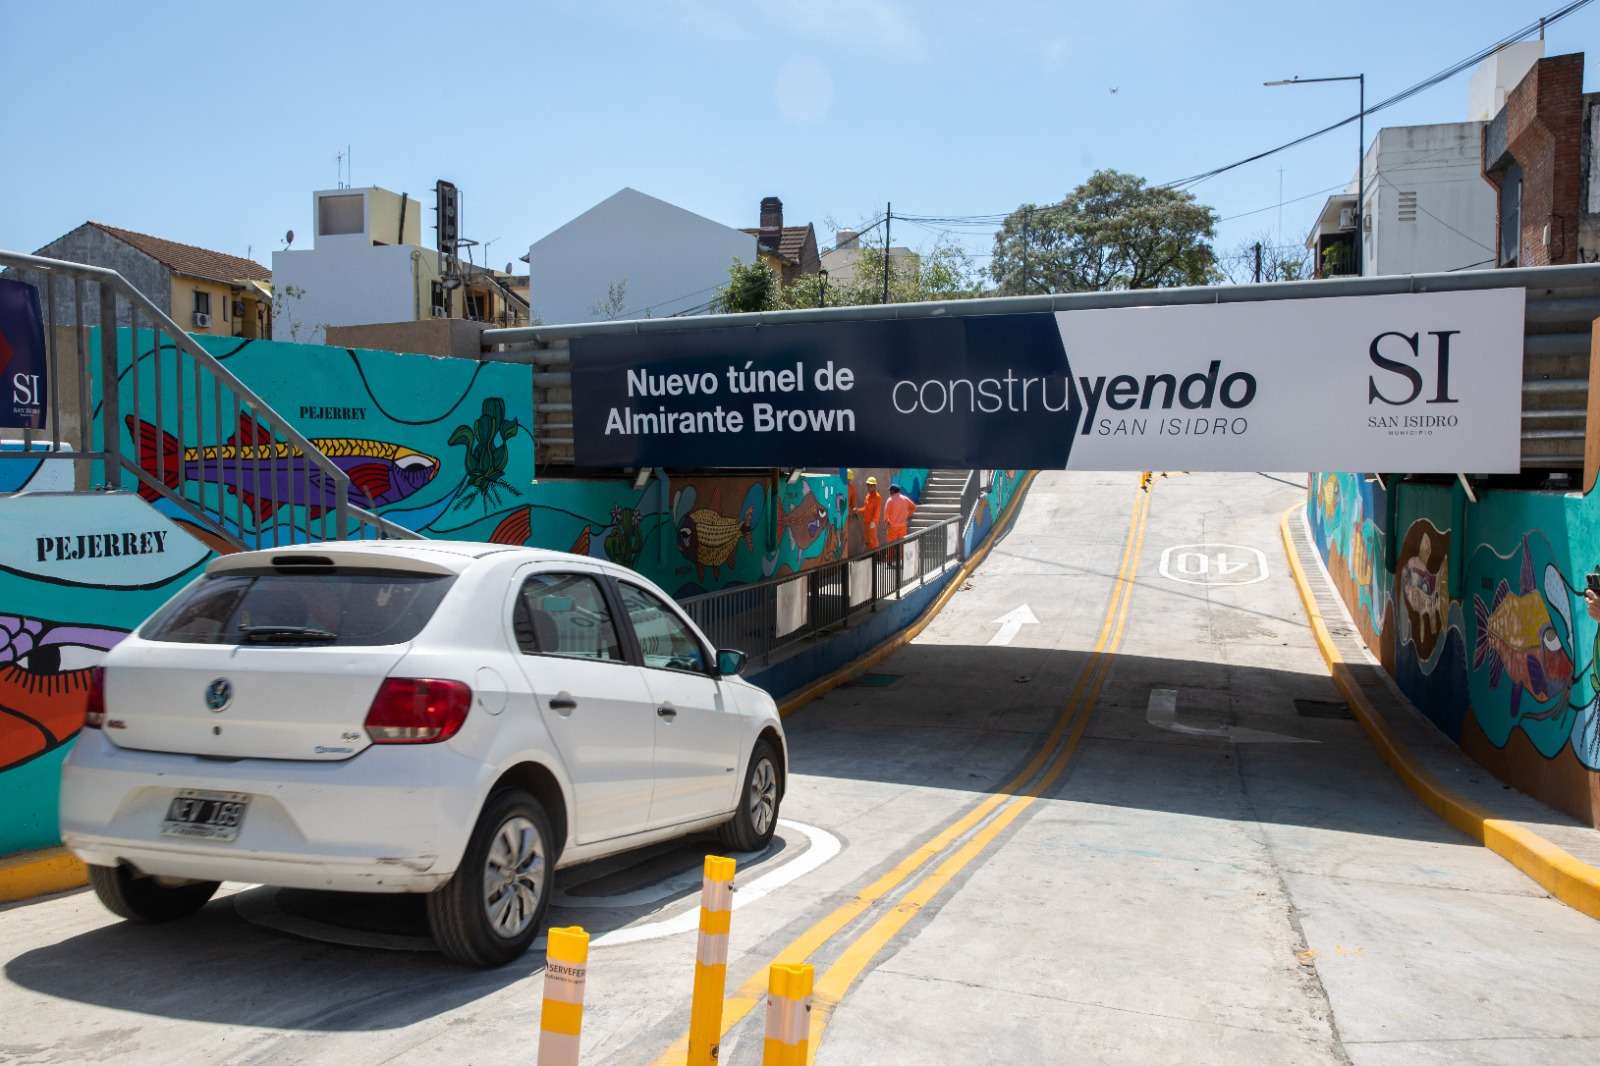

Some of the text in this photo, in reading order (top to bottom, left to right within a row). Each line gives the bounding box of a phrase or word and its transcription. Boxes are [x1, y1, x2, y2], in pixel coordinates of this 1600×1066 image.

[627, 360, 855, 397] Nuevo túnel de
[1368, 330, 1461, 406] SI
[13, 372, 40, 405] SI
[300, 406, 366, 420] PEJERREY
[604, 402, 856, 435] Almirante Brown
[1098, 416, 1249, 436] SAN ISIDRO
[1368, 415, 1459, 428] SAN ISIDRO
[36, 530, 168, 562] PEJERREY
[1177, 553, 1249, 575] 40
